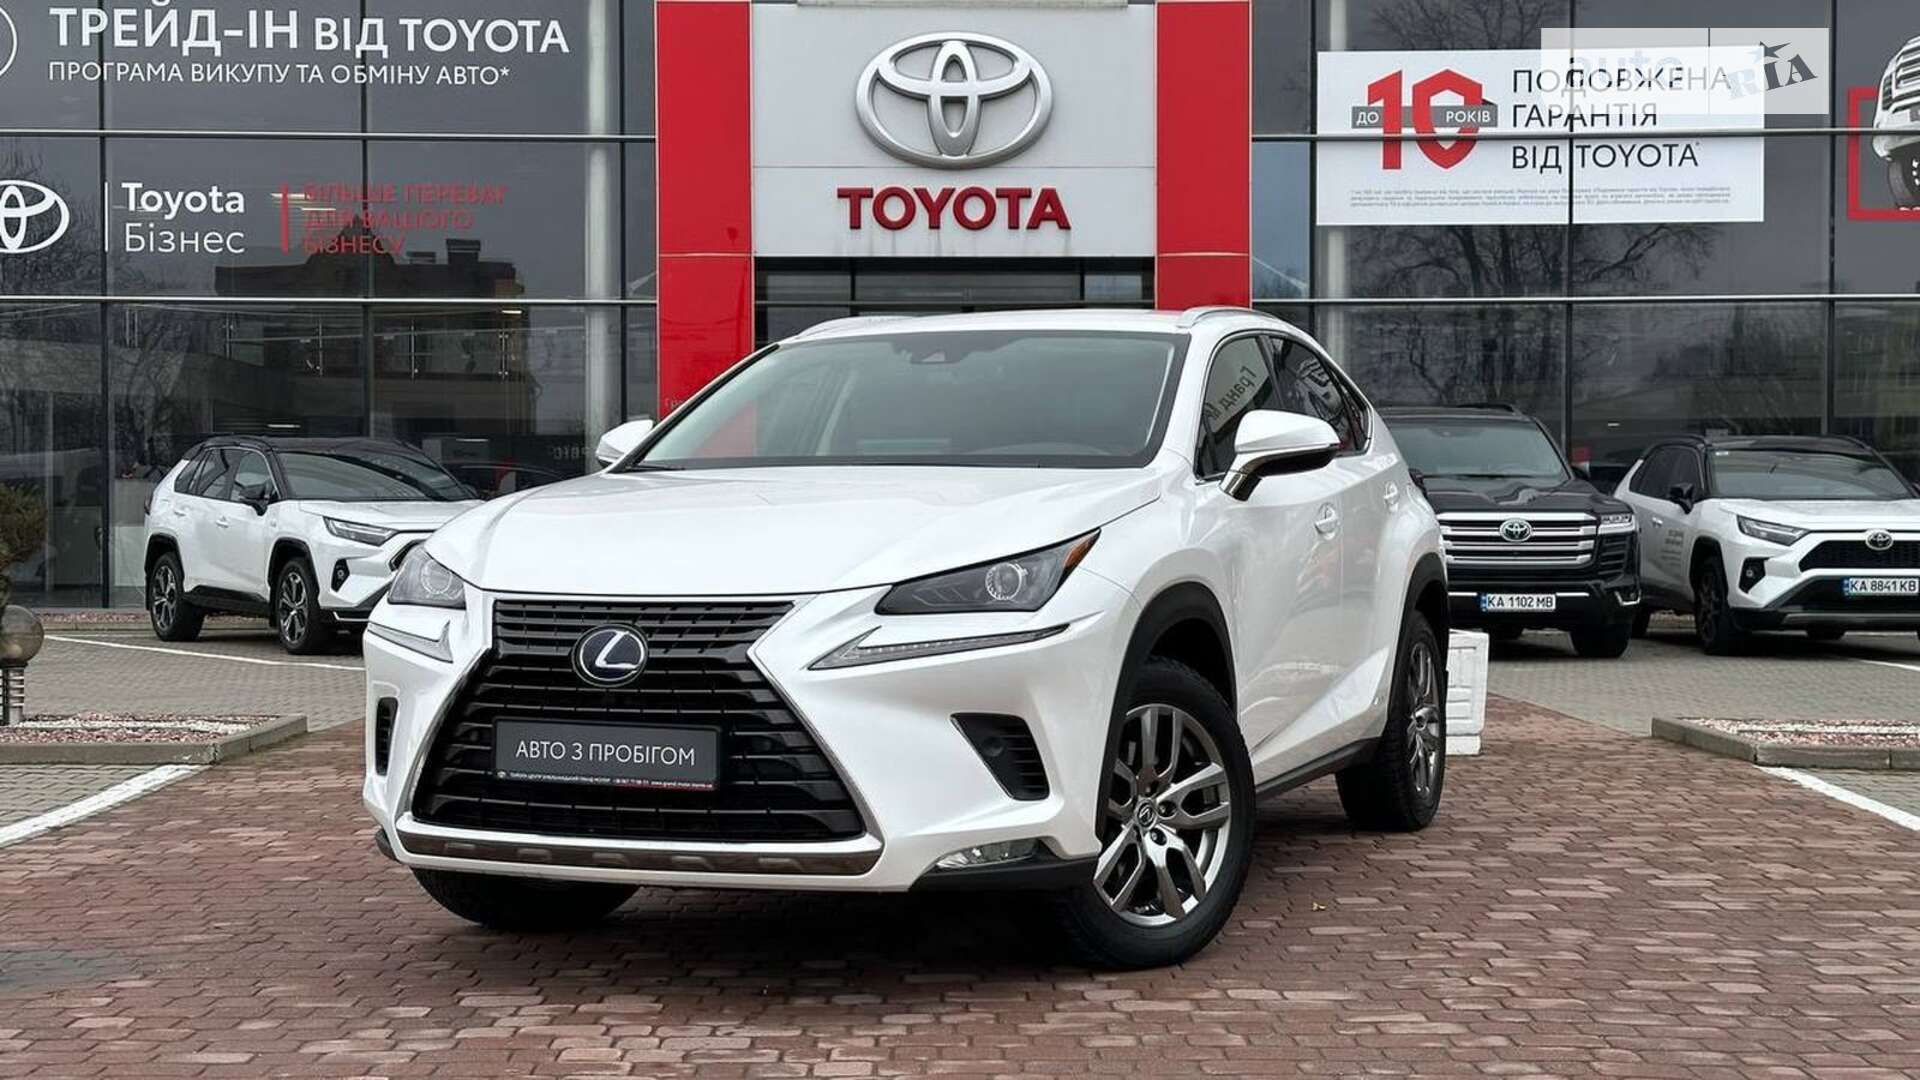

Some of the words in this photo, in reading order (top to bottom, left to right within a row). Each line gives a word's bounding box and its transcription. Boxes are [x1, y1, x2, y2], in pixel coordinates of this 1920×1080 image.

[50, 0, 298, 57] ТРЕЙД-ІН
[314, 18, 388, 58] ВІД
[399, 19, 570, 53] TOYOTA
[49, 61, 184, 83] ПРОГРАМА
[191, 63, 290, 84] ВИКУПУ
[296, 64, 324, 84] ТА
[331, 64, 430, 85] ОБМІНУ
[1512, 67, 1731, 97] ПОДОВЖЕНА
[1356, 111, 1380, 125] ДО
[1367, 69, 1483, 169] 10
[1446, 110, 1491, 123] РОКІВ
[1512, 102, 1657, 127] ГАРАНТІЯ
[1511, 146, 1562, 174] ВІД
[121, 182, 245, 220] Toyota
[837, 187, 1071, 231] TOYOTA
[125, 222, 245, 253] Бізнес
[1508, 596, 1534, 607] 1102
[515, 740, 566, 760] АВТО
[588, 743, 696, 766] ПРОБІГОМ
